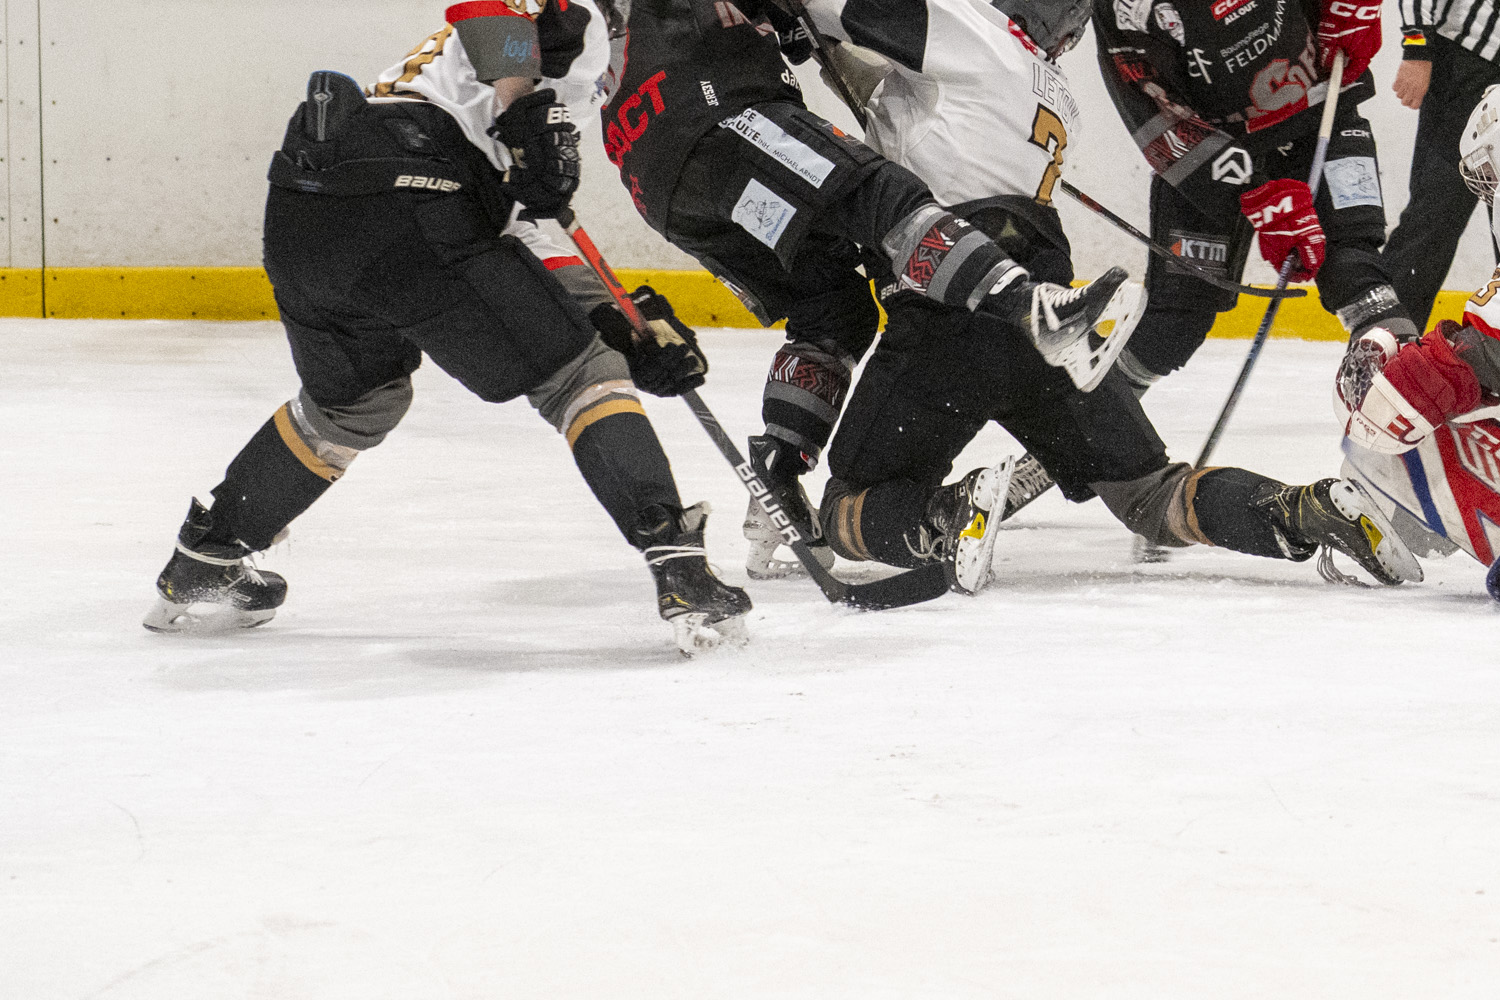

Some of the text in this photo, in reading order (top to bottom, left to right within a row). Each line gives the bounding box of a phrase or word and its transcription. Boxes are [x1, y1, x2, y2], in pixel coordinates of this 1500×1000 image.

[1224, 10, 1242, 26] ALL
[1329, 1, 1382, 20] CC
[773, 149, 800, 171] MICHAEL
[799, 168, 821, 185] ARNDT
[1027, 102, 1068, 206] 7
[1179, 238, 1227, 262] KTM
[735, 461, 801, 546] BAUER
